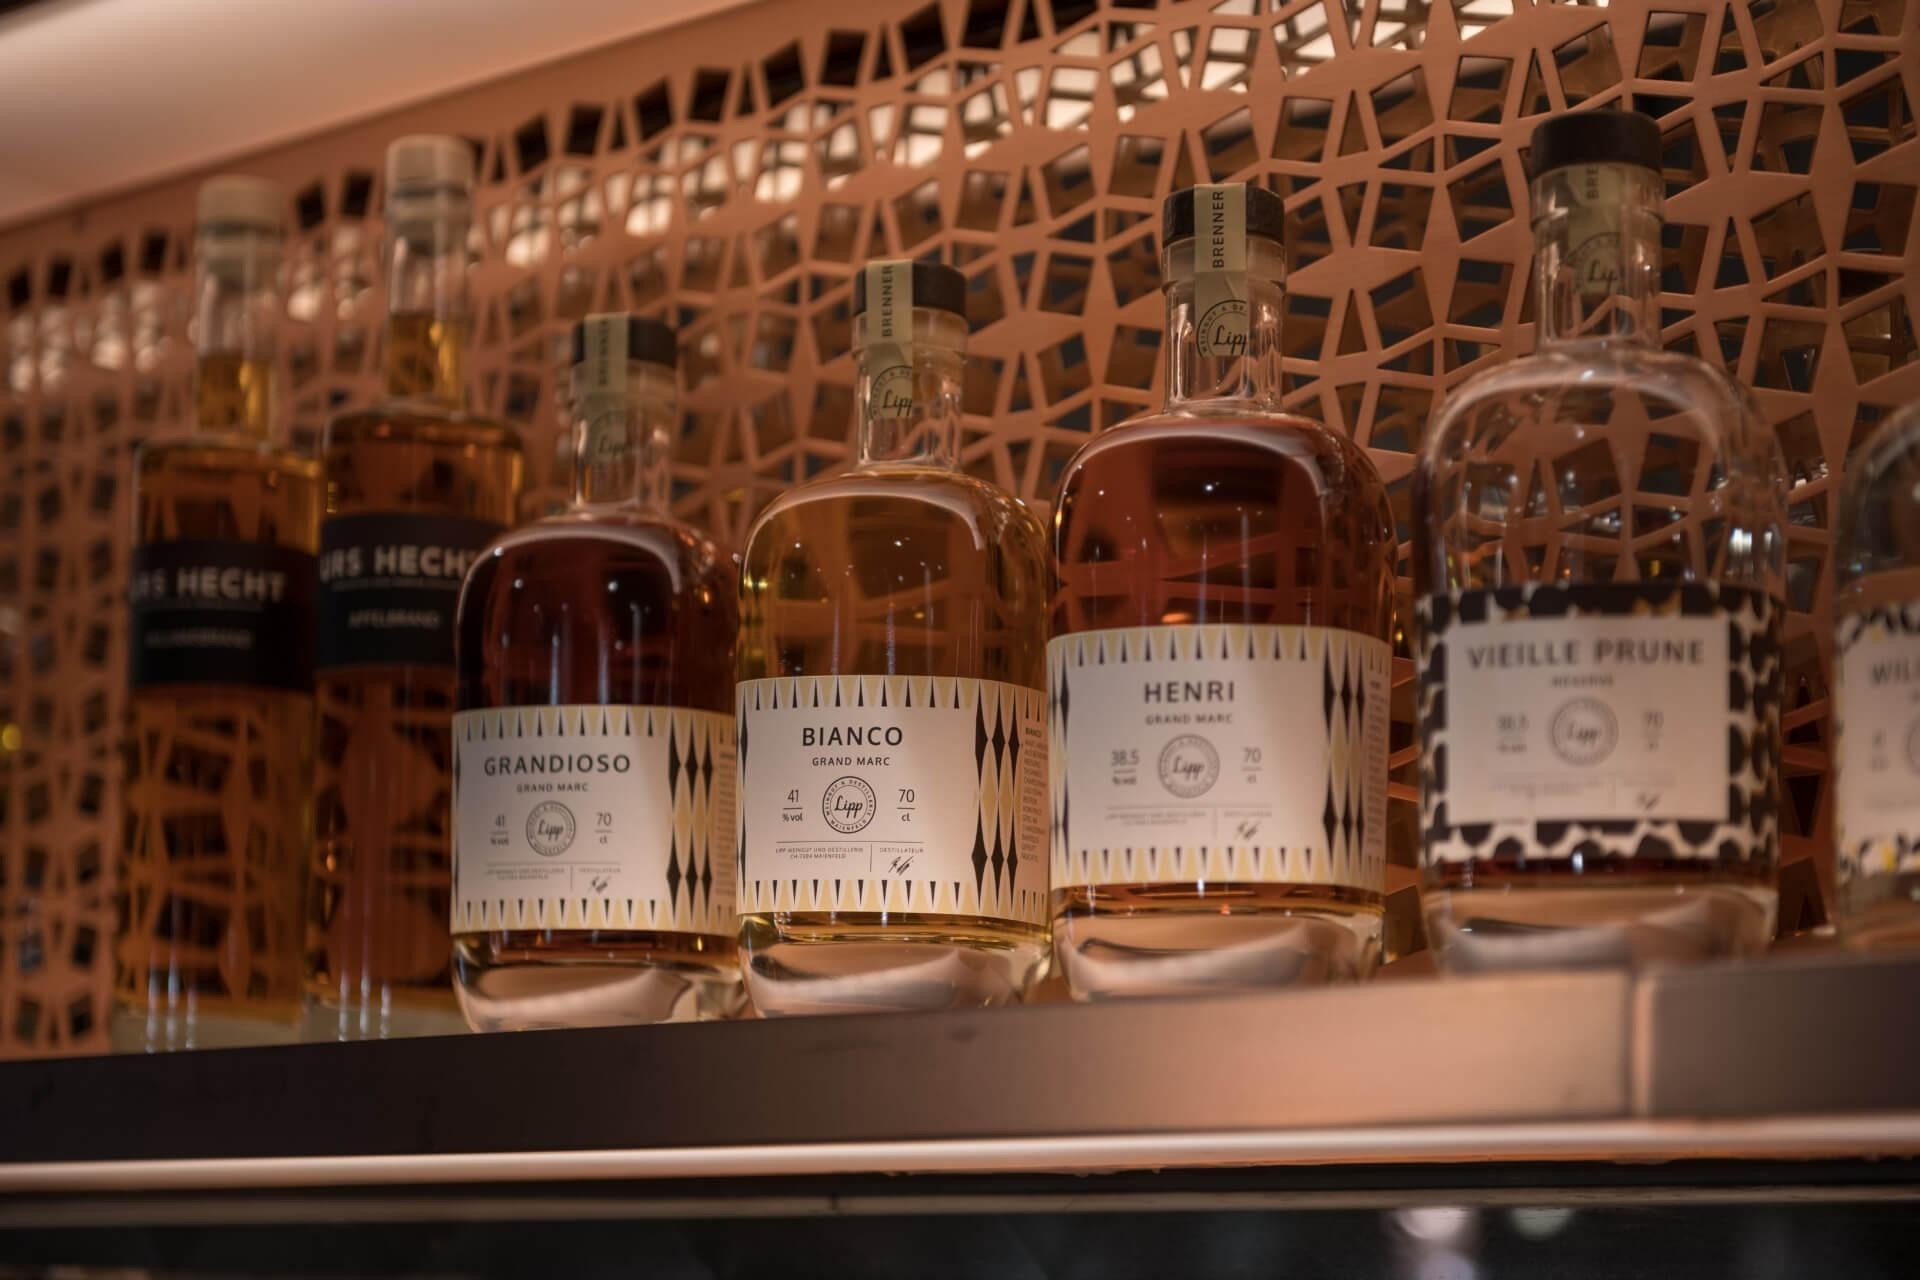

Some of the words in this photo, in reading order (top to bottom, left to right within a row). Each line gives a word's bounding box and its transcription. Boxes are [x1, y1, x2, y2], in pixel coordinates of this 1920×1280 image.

[1212, 191, 1225, 268] BRENNER
[881, 265, 894, 337] BRENNER
[176, 565, 288, 604] HECHT
[1468, 642, 1578, 668] VIEILLE
[1595, 640, 1704, 664] PRUNE
[1871, 660, 1920, 685] WIL
[1144, 681, 1235, 704] HENRI
[1145, 714, 1192, 725] GRAND
[1196, 713, 1234, 724] MARC
[802, 726, 903, 747] BIANCO
[484, 753, 632, 776] GRANDIOSO
[812, 756, 852, 767] GRAND
[856, 755, 891, 766] MARC
[1111, 748, 1141, 766] 38.5
[1172, 754, 1206, 781] Lipp
[1243, 747, 1263, 763] 70
[517, 782, 554, 794] GRAND
[557, 782, 590, 793] MARC
[787, 789, 800, 804] 41
[834, 795, 864, 819] Lipp
[898, 788, 916, 803] 70
[537, 821, 564, 842] Lipp
[596, 812, 613, 827] 70
